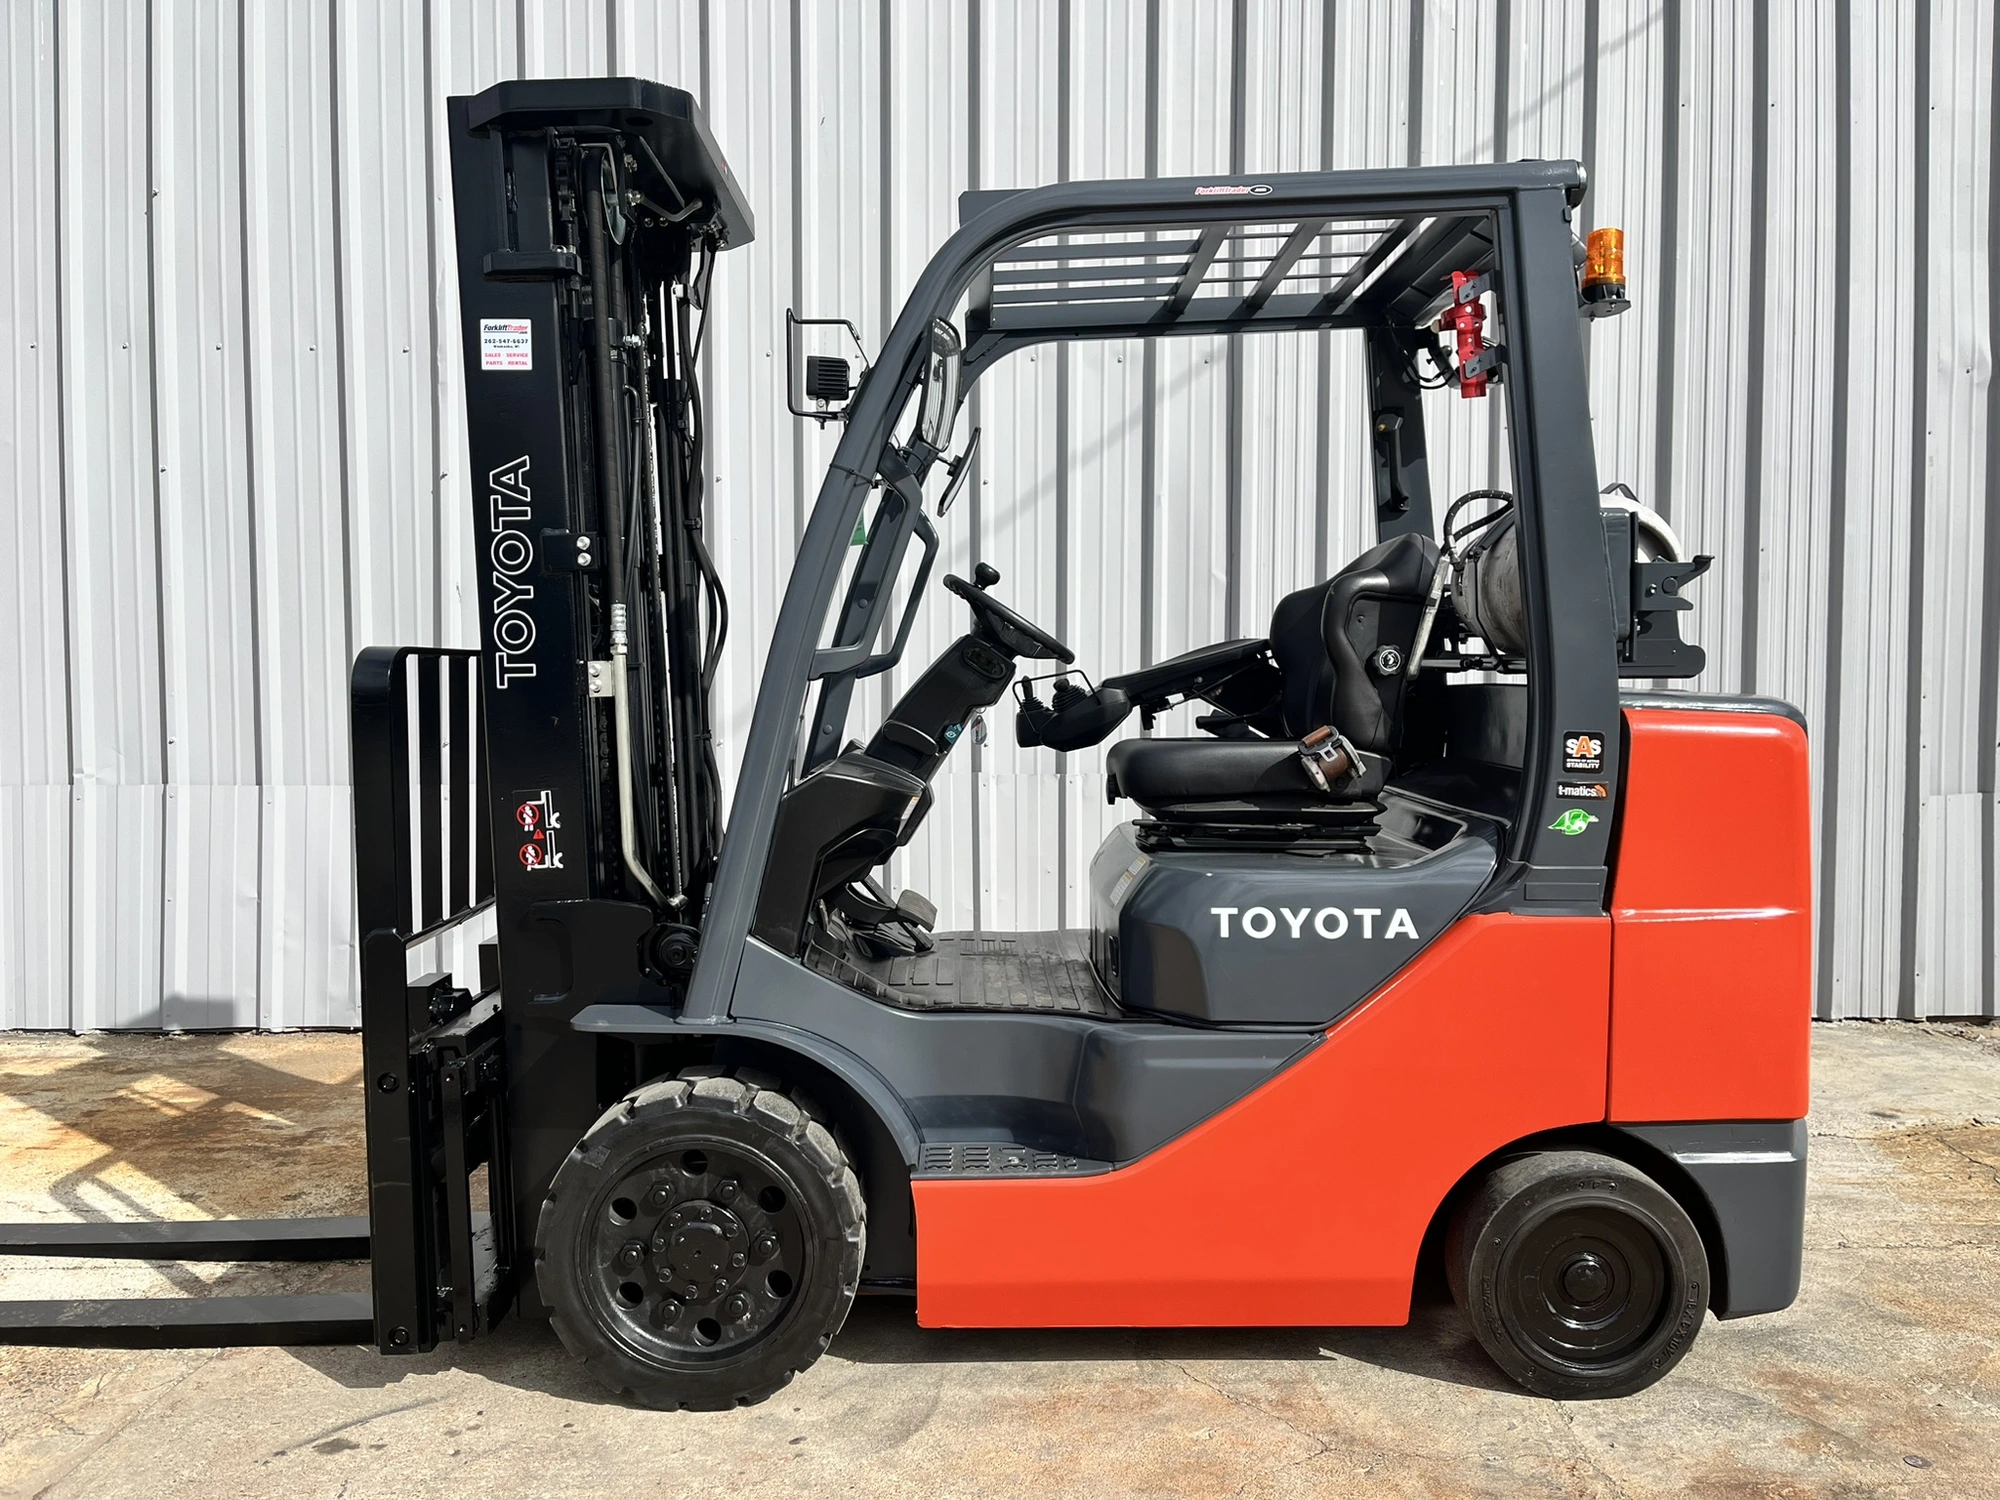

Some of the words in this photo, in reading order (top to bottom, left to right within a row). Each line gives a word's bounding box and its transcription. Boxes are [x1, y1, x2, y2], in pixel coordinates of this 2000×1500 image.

[489, 455, 537, 690] TOYOTA
[1565, 735, 1602, 758] SAS
[1558, 785, 1598, 797] t-matics
[1210, 906, 1420, 940] TOYOTA
